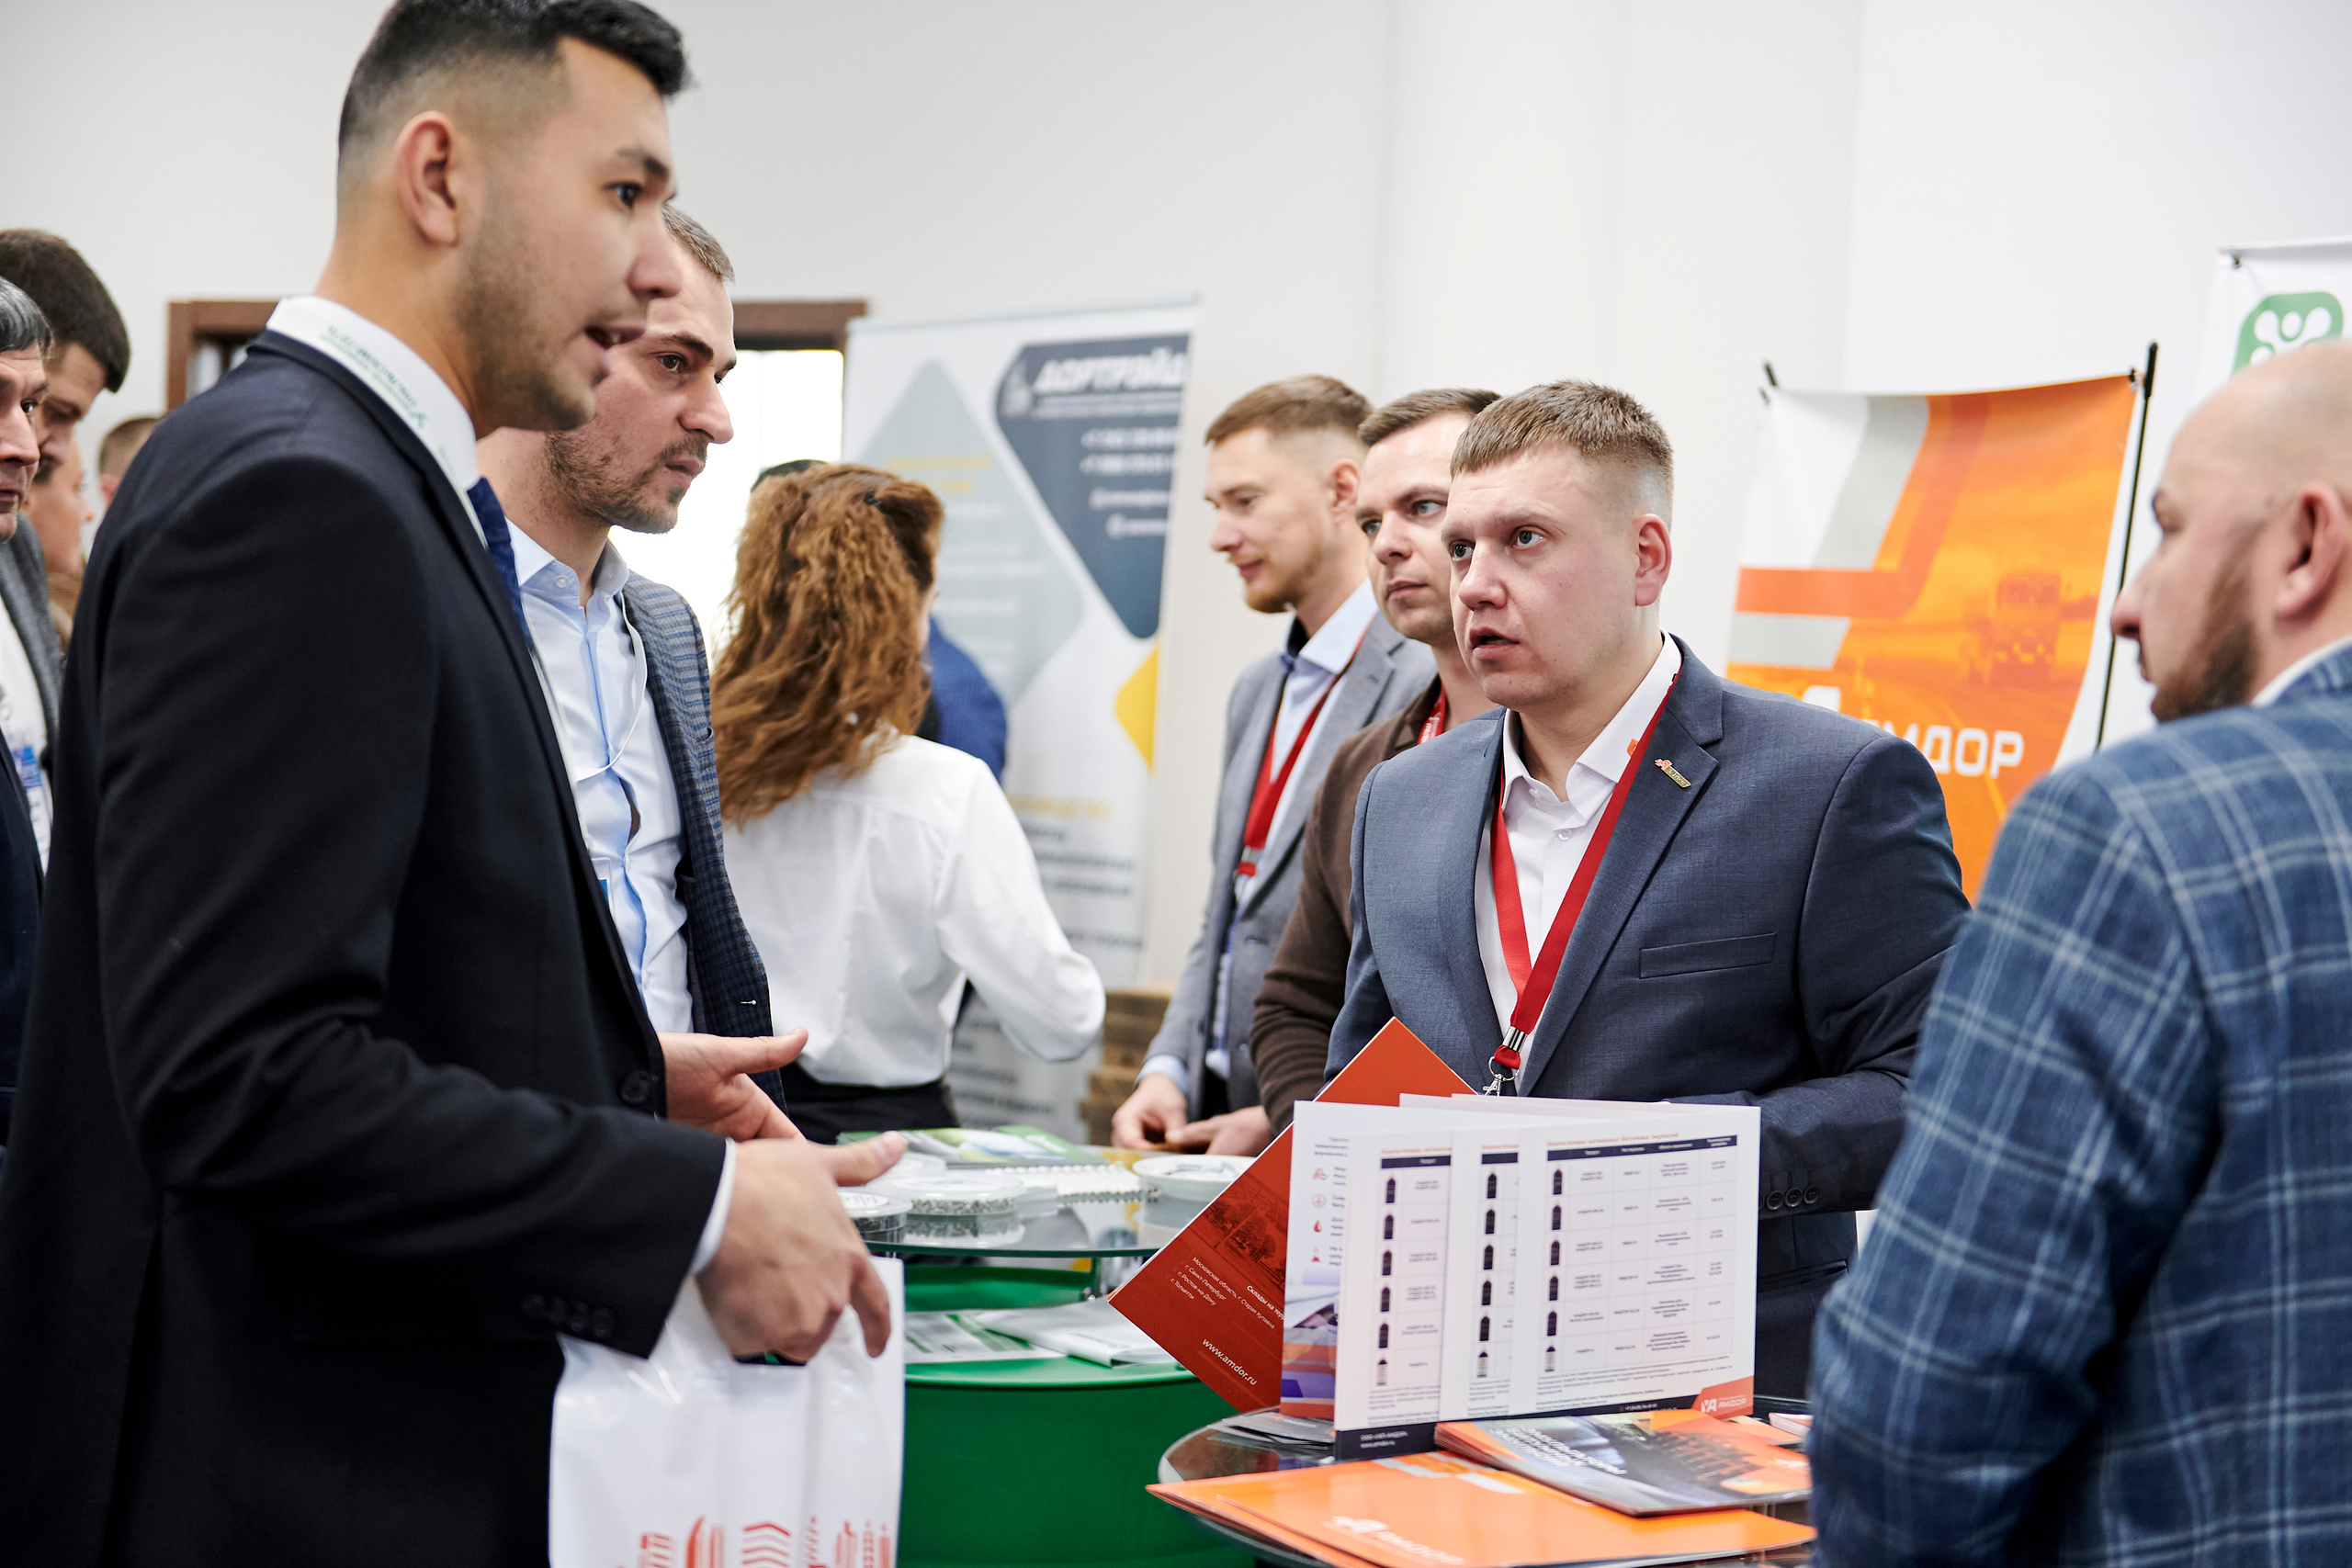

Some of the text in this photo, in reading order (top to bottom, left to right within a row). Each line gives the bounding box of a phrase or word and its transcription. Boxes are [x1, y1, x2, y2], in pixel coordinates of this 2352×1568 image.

[1174, 1280, 1194, 1300] Тольятти
[1181, 1274, 1216, 1305] Ростов-на-Дону
[1188, 1267, 1227, 1301] Санкт-Петербург
[1193, 1257, 1219, 1282] Московская
[1240, 1299, 1257, 1314] Старая
[1256, 1312, 1275, 1329] Купавна
[1247, 1285, 1267, 1304] Склады
[1266, 1302, 1274, 1310] на
[1202, 1337, 1258, 1386] www.amdor.ru
